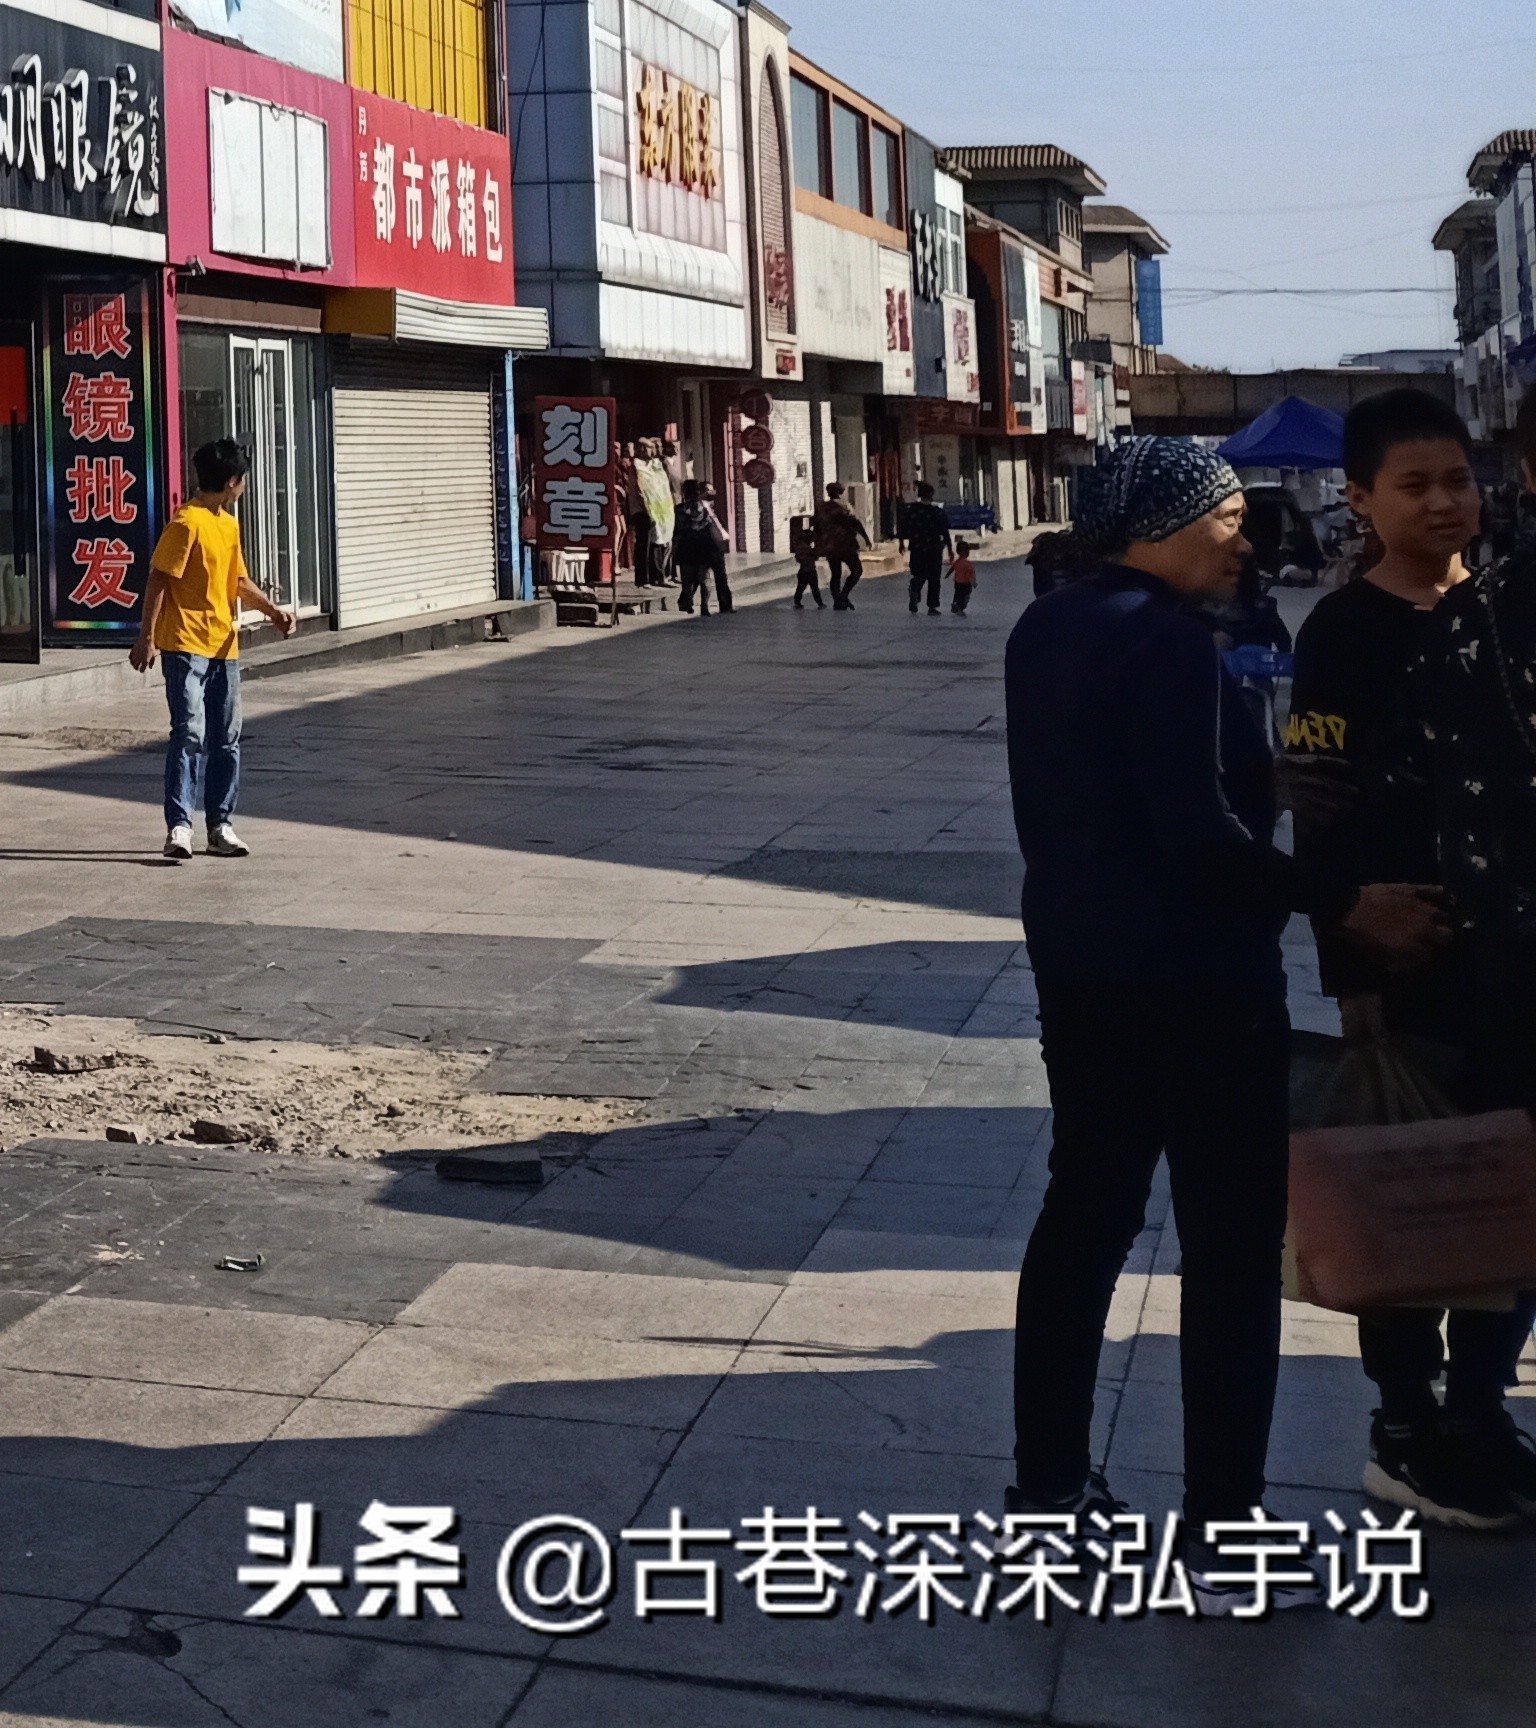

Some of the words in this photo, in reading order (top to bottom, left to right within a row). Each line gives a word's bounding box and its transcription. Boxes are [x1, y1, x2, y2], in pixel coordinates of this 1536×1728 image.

[372, 136, 503, 264] 都市派箱包
[62, 293, 139, 610] 眼镜批发
[542, 403, 609, 543] 刻章
